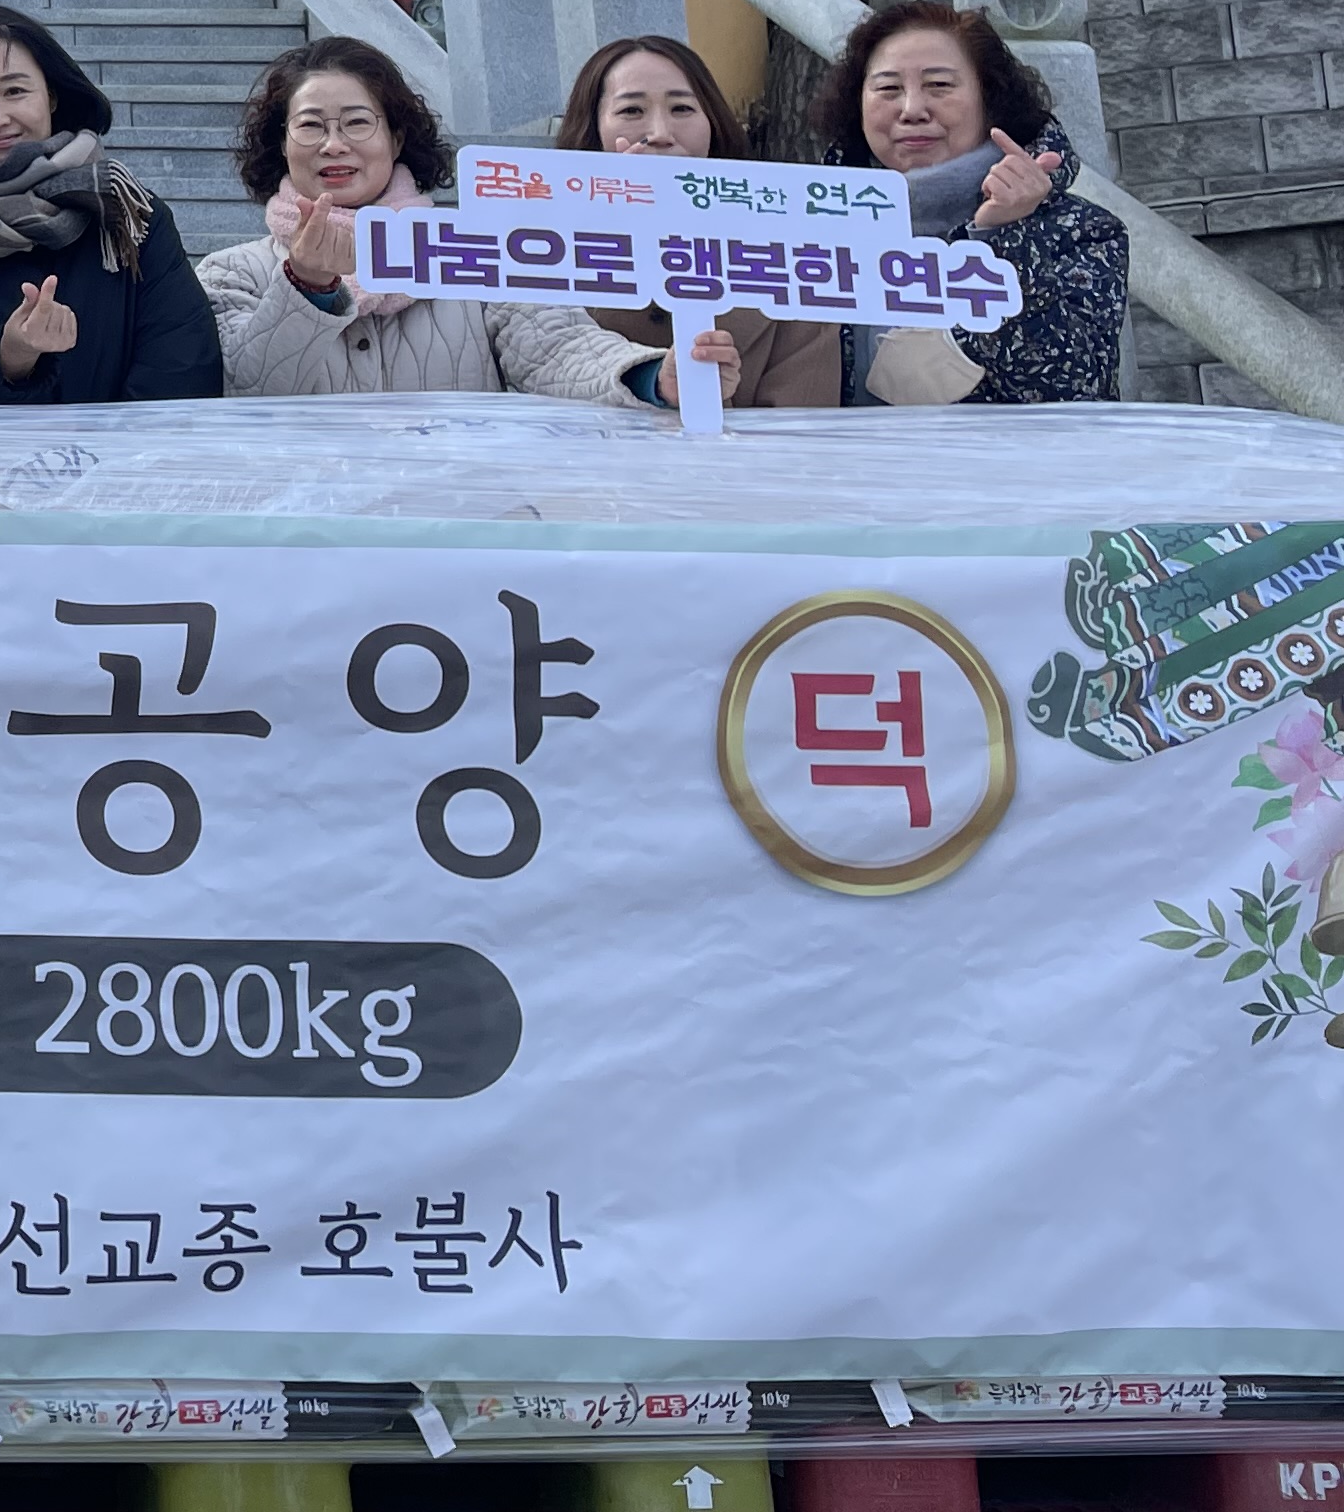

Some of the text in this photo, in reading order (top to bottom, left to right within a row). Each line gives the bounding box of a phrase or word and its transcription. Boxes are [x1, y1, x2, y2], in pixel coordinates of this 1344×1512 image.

[475, 160, 896, 220] 꿈을 이루는 행복한 연수
[370, 221, 1010, 318] 나눔으로 행복한 연수
[791, 671, 929, 829] 덕
[33, 960, 424, 1086] 2800kg
[300, 1191, 583, 1294] 호불사
[117, 1379, 178, 1433] 강화
[178, 1400, 221, 1424] 교동
[221, 1399, 277, 1431] 섬쌀
[298, 1398, 329, 1416] 10kg
[583, 1383, 645, 1429] 강화
[645, 1394, 687, 1418] 교동
[688, 1394, 743, 1424] 섬쌀
[760, 1392, 791, 1407] 10kg
[1120, 1383, 1160, 1405] 교동
[1237, 1383, 1268, 1400] 10kg
